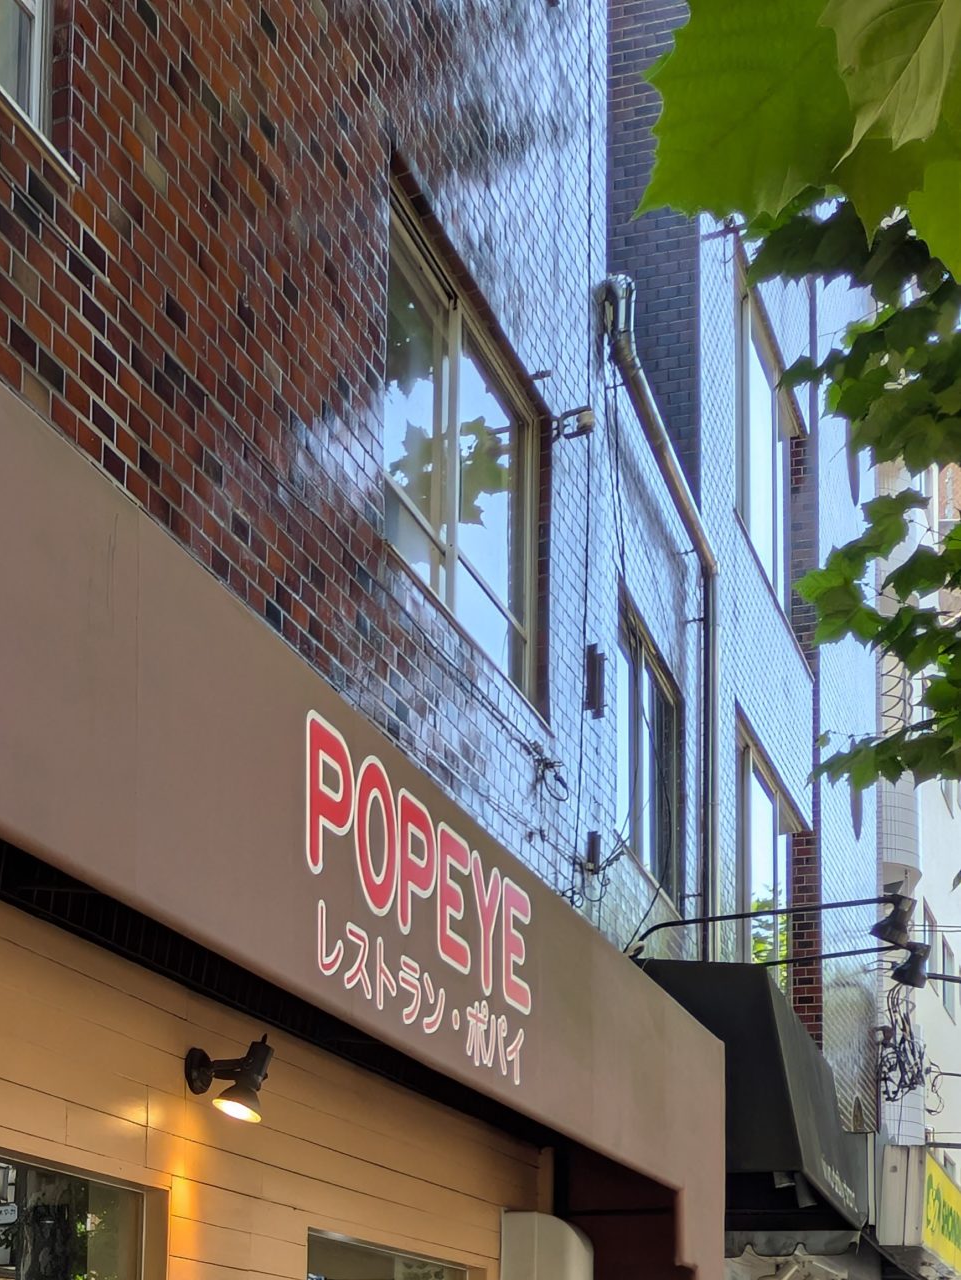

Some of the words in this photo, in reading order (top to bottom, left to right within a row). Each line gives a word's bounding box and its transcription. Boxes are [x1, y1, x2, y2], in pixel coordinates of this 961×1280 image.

[306, 709, 531, 1015] POPEYE
[317, 900, 524, 1085] レストラン・ポパイ
